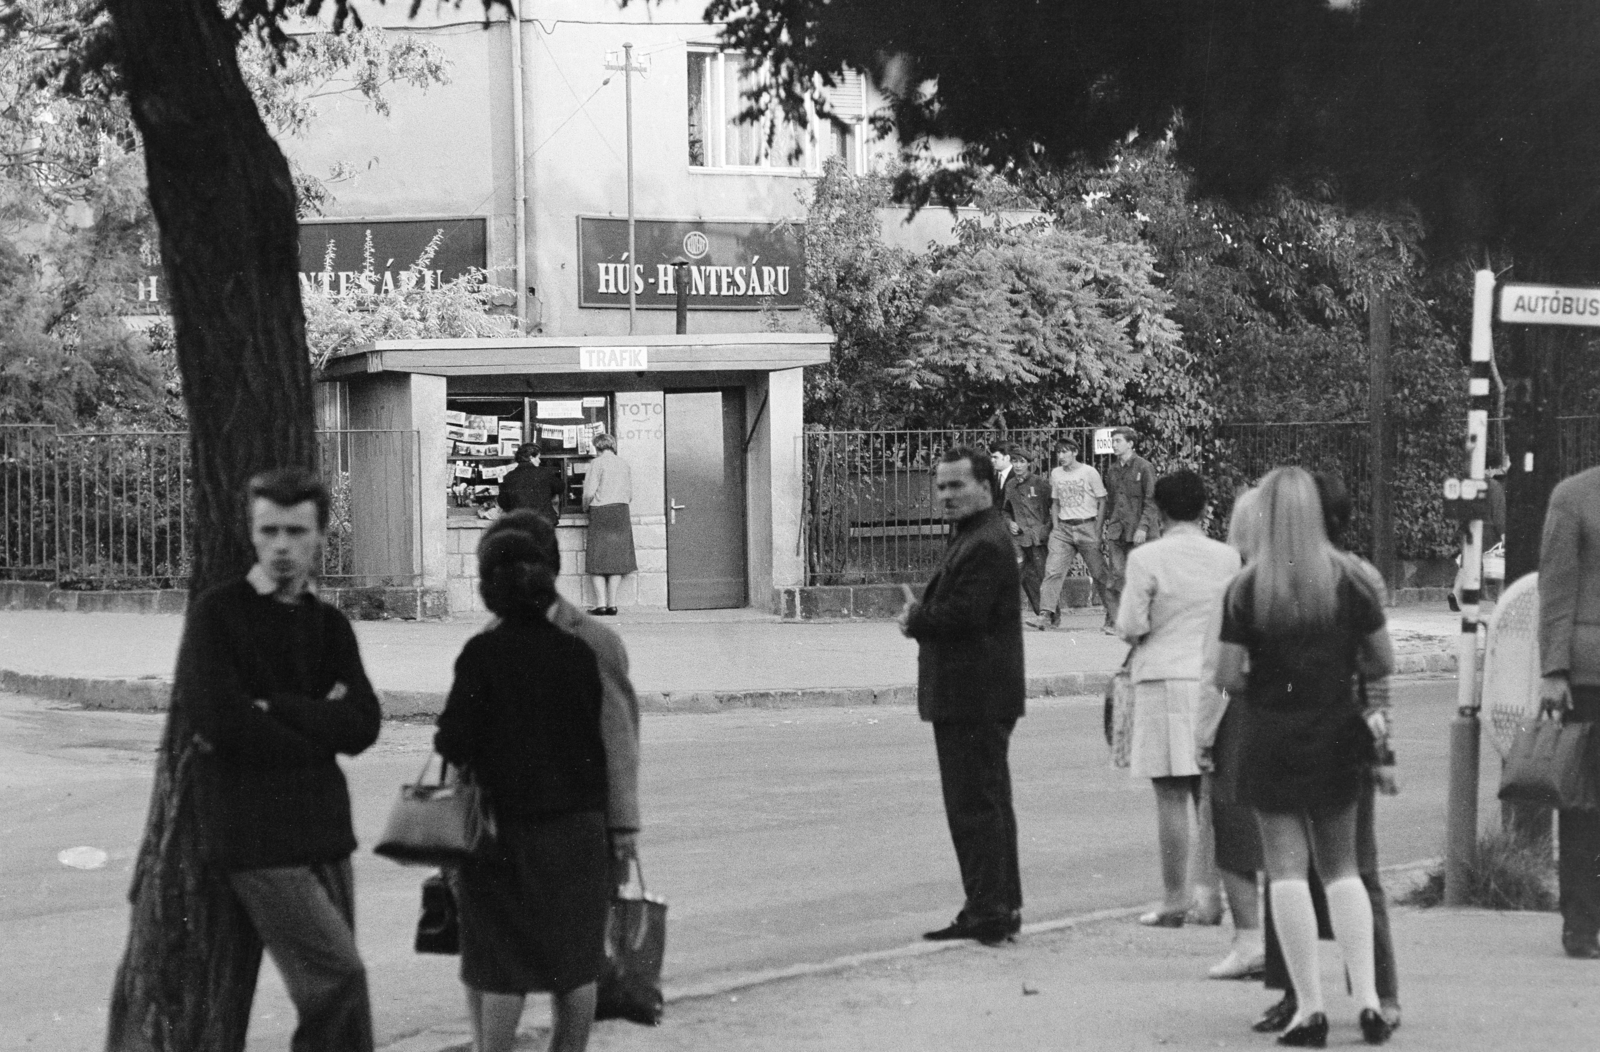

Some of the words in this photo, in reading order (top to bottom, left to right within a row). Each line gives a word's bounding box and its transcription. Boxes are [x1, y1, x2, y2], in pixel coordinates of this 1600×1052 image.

[597, 252, 790, 296] HÚS-HNTESÁRU
[1514, 290, 1600, 316] AUTÓBUS
[585, 349, 643, 367] TRAFIK
